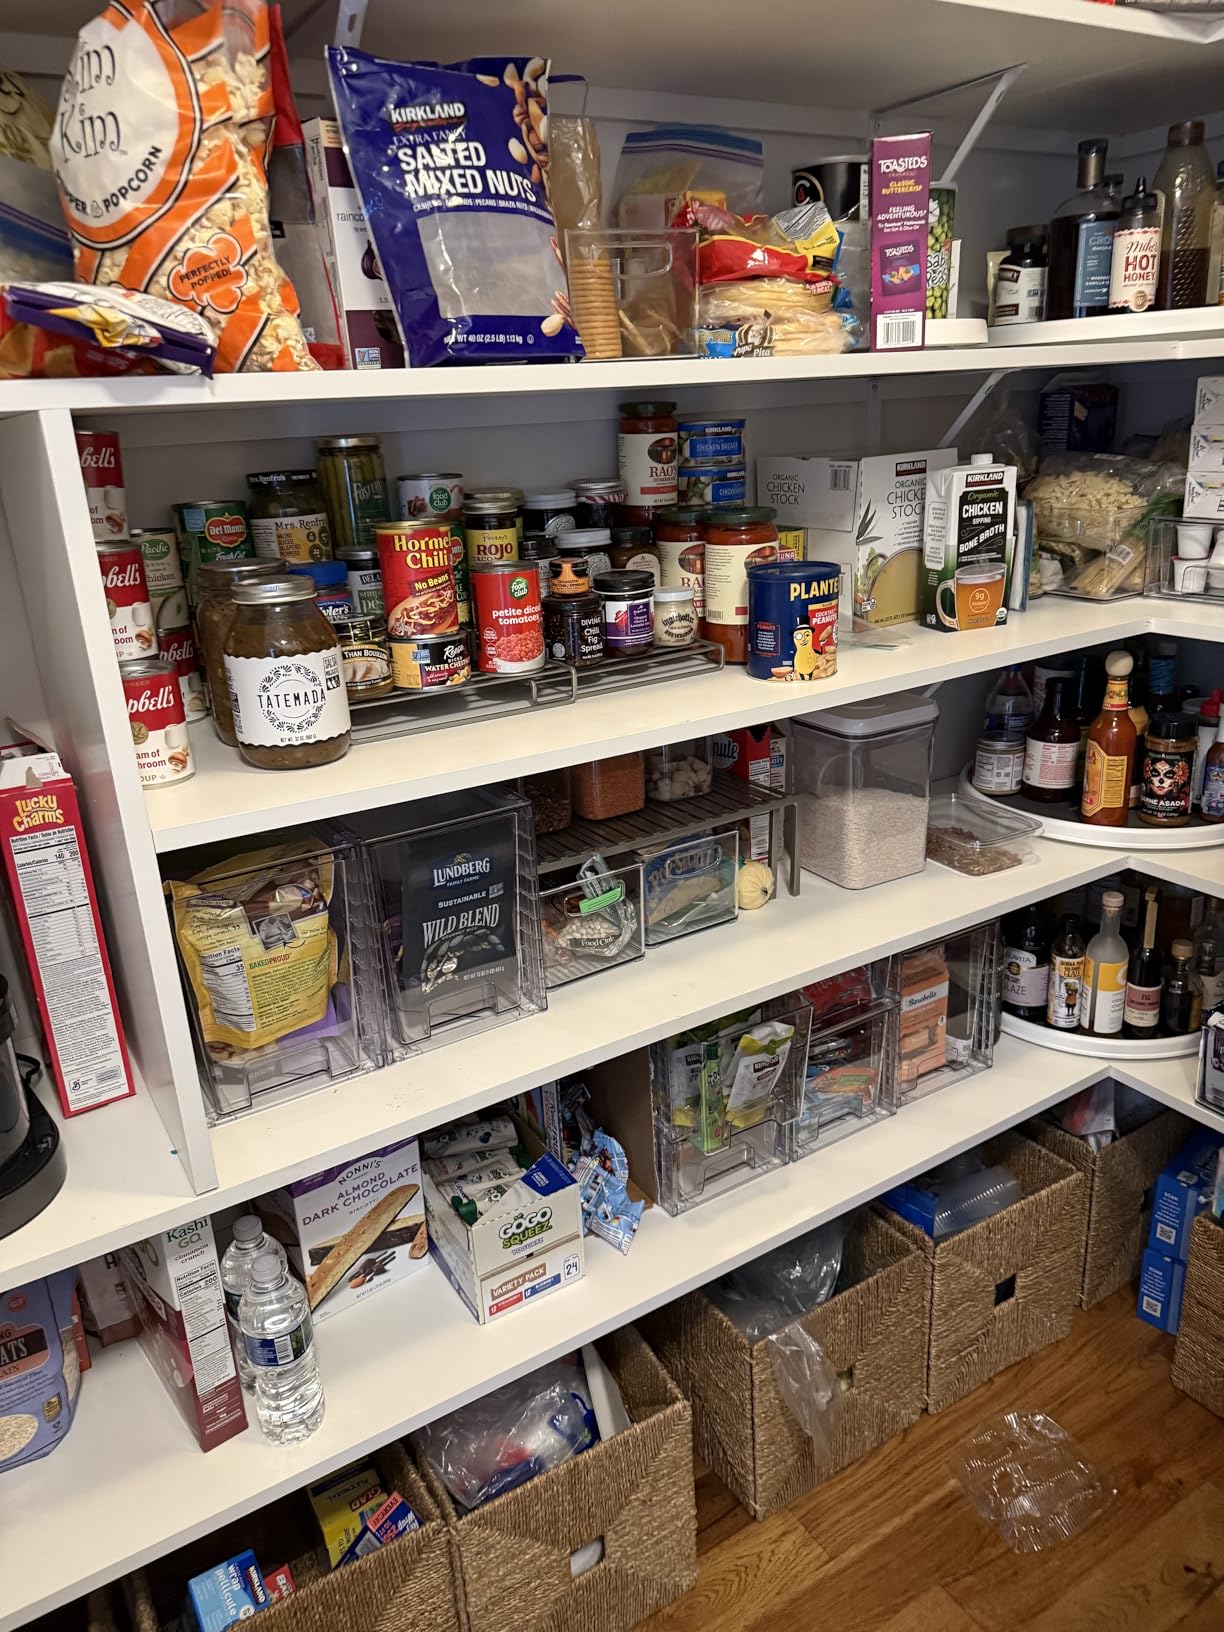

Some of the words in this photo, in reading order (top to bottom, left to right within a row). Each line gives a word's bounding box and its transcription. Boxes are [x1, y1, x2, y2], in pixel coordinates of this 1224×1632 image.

[390, 102, 465, 123] KIRKLAND
[397, 141, 487, 172] SALTED
[878, 155, 928, 174] TOASTEDS
[103, 145, 163, 213] POPCORN
[404, 165, 483, 199] MIXED
[485, 169, 537, 203] NUTS
[336, 211, 365, 223] rainco
[179, 254, 232, 284] PERFECTLY
[1124, 254, 1158, 273] HOT
[190, 267, 233, 290] POPPED!
[1123, 270, 1156, 283] HONEY
[80, 447, 115, 469] bell's
[896, 460, 927, 472] KIRKLAND
[772, 473, 799, 482] ORGANIC
[966, 471, 1004, 484] KIRKLAND
[766, 482, 805, 493] CHICKEN
[886, 487, 926, 505] CHICKE
[967, 490, 999, 501] Organic
[432, 492, 449, 501] food
[433, 498, 449, 507] club
[770, 492, 800, 505] STOCK
[892, 502, 924, 519] STOC
[962, 501, 1004, 519] CHICKEN
[275, 521, 298, 531] Mrs.
[972, 516, 992, 524] SIPPING
[209, 525, 223, 536] Del
[958, 536, 980, 554] BONE
[979, 523, 1005, 543] BROTH
[141, 540, 169, 554] Pacific
[476, 542, 514, 560] ROJO
[405, 550, 449, 570] Chili
[103, 563, 142, 588] bell's
[147, 572, 176, 584] hicken
[413, 579, 428, 591] No
[427, 573, 450, 586] Beans
[510, 580, 526, 593] food
[514, 588, 528, 598] club
[789, 577, 839, 602] PLANTE
[975, 591, 985, 601] 9g
[492, 607, 522, 620] petite
[498, 613, 540, 626] tomatoes
[812, 613, 837, 626] PEANUTS
[118, 625, 128, 635] of
[584, 626, 600, 637] Chili
[580, 643, 603, 653] Spread
[588, 636, 598, 646] Fig
[343, 651, 363, 660] THAN
[424, 664, 449, 673] WATER
[128, 686, 175, 714] pbell's
[257, 687, 327, 709] TATEMADA
[150, 750, 161, 759] of
[713, 738, 738, 759] nute
[137, 759, 167, 770] hroom
[141, 774, 158, 783] OUP
[15, 794, 58, 818] Lucky
[1158, 798, 1186, 808] ASADA
[13, 809, 65, 832] Charms
[54, 852, 65, 860] 140
[433, 857, 490, 888] LUNDBERG
[447, 879, 463, 888] FAMILY
[438, 890, 487, 909] SUSTAINABLE
[422, 916, 456, 949] WILD
[458, 903, 500, 929] BLEND
[223, 946, 241, 956] Facts
[580, 938, 599, 948] Food
[1008, 984, 1027, 996] LAZE
[338, 1159, 384, 1186] NONNI'S
[302, 1203, 340, 1227] DARK
[342, 1163, 419, 1208] CHOCOLATE
[337, 1172, 386, 1201] ALMOND
[166, 1217, 209, 1244] Kashi
[498, 1206, 553, 1240] GOGO
[178, 1233, 202, 1249] GO
[502, 1219, 551, 1250] SQUEEZ
[174, 1243, 210, 1262] cinnamon
[180, 1250, 206, 1264] crunch
[176, 1268, 199, 1282] Nutrition
[199, 1261, 216, 1273] Facts
[566, 1262, 579, 1277] 24
[179, 1284, 202, 1297] Calories
[204, 1276, 218, 1286] 200
[493, 1275, 525, 1298] VARIETY
[524, 1266, 545, 1281] PACK
[0, 1337, 28, 1365] ATS
[227, 1563, 242, 1591] wrap
[248, 1565, 266, 1604] KIRKLAND
[215, 1567, 238, 1616] pellicule
